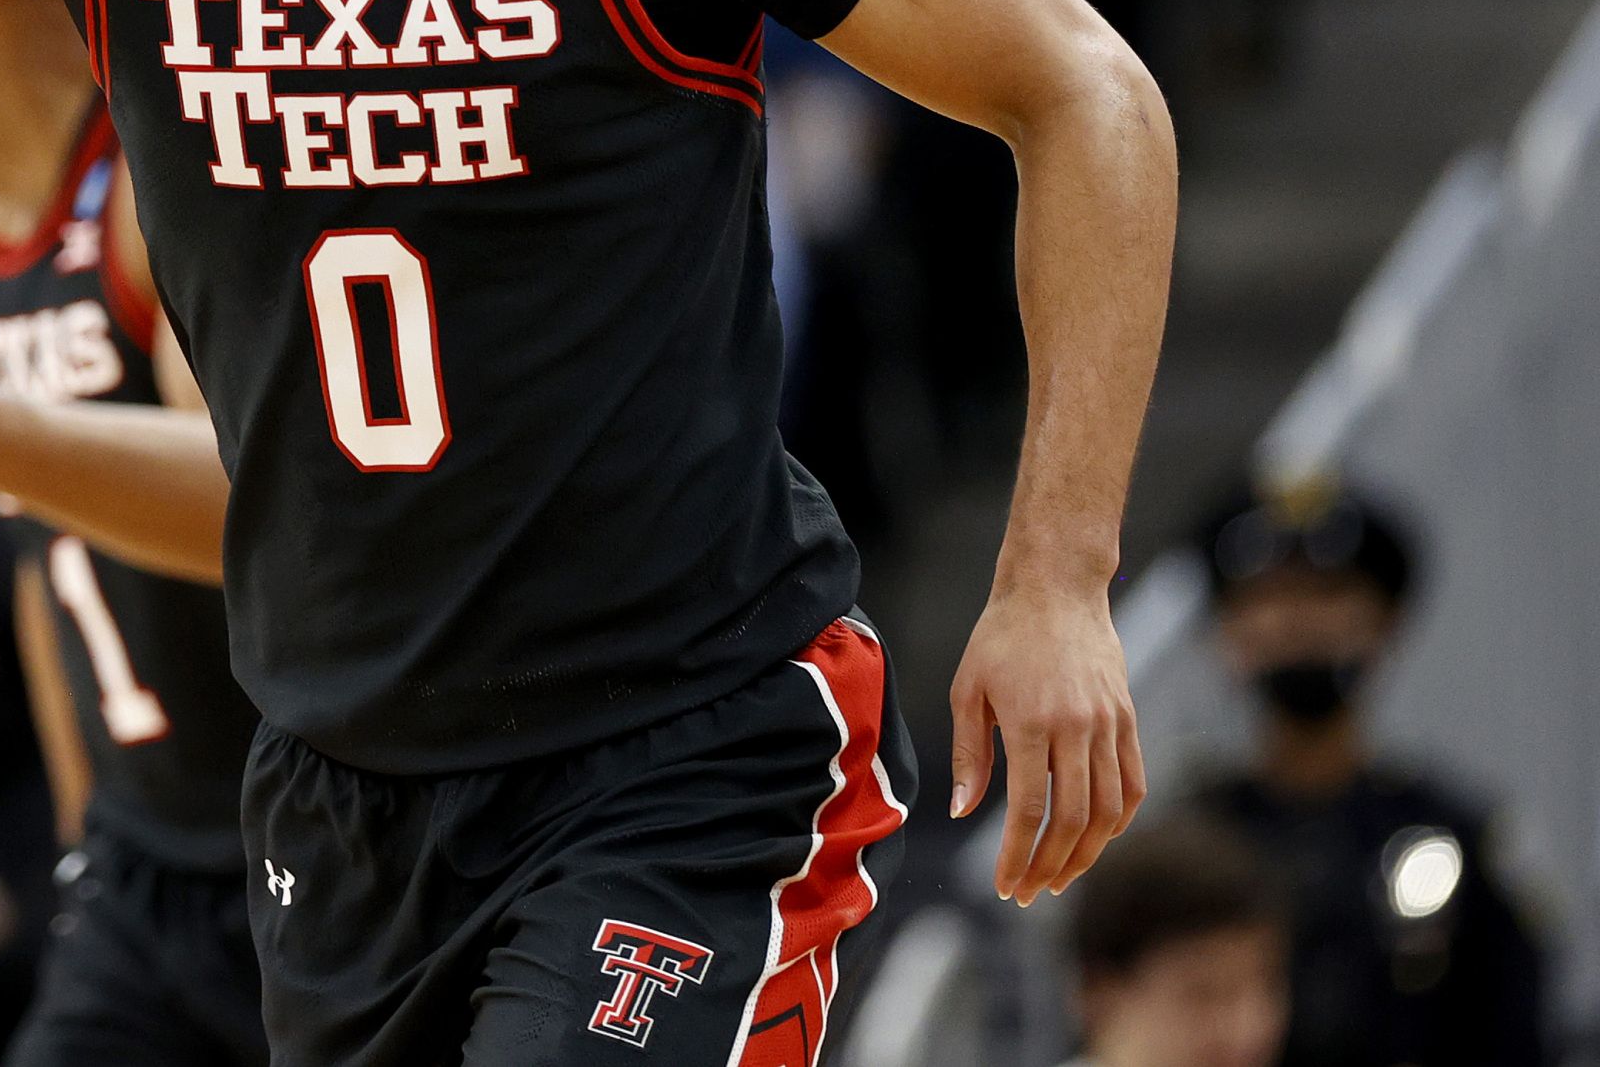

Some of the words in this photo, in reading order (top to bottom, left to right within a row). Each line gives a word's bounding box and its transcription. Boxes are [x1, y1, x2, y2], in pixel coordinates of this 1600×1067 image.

[175, 69, 531, 189] TECH
[302, 227, 452, 472] 0
[50, 534, 172, 745] 1
